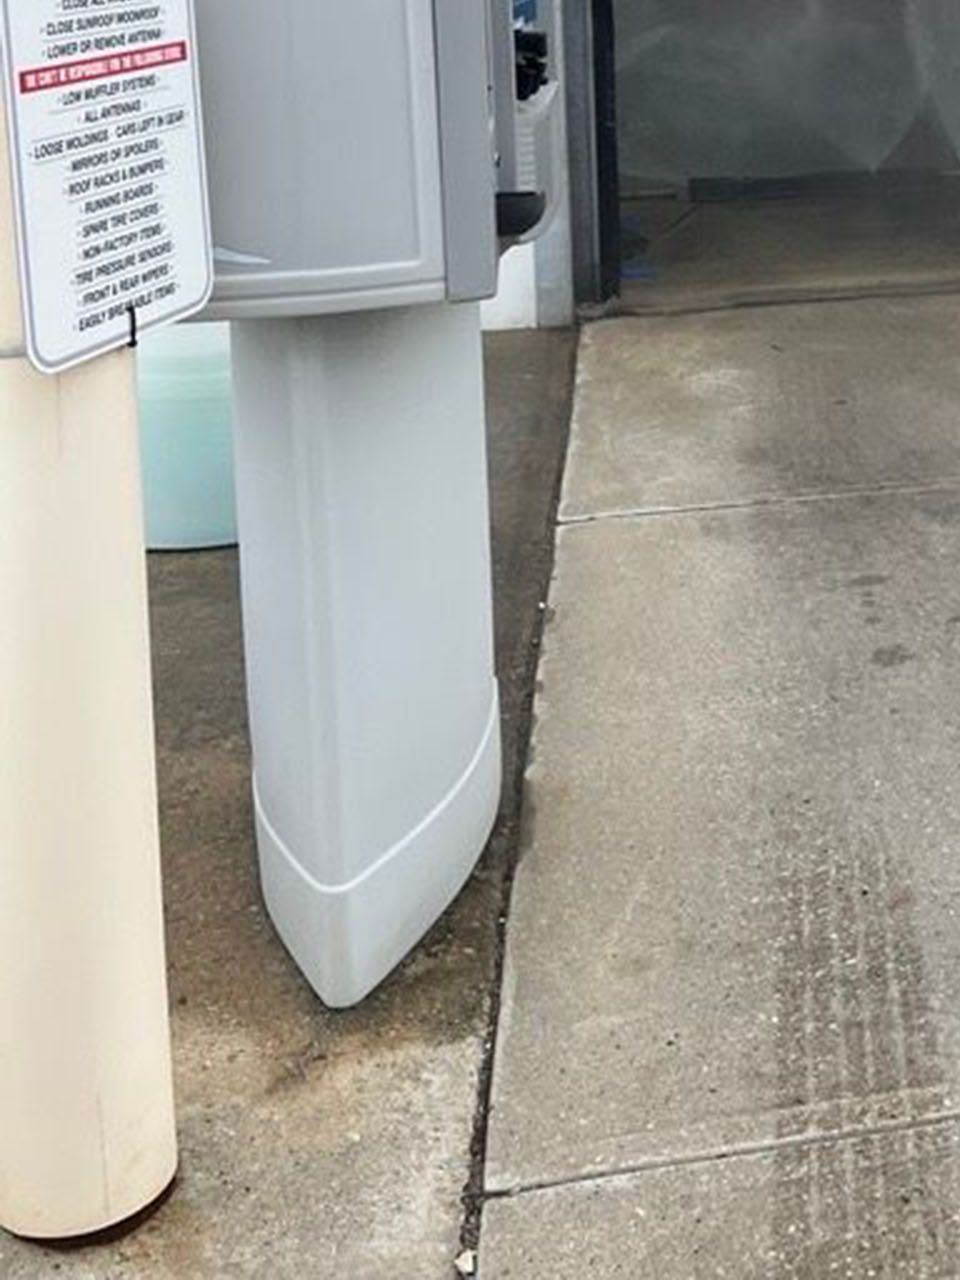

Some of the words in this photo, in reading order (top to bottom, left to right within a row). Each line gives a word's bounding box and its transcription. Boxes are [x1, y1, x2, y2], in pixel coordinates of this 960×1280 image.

[46, 20, 74, 36] CLOSE
[48, 43, 78, 59] LOWER
[80, 40, 92, 53] OR
[94, 32, 126, 50] REMOVE
[62, 90, 82, 106] LOW
[84, 82, 120, 100] MUFFLER
[122, 74, 157, 92] SYSTEMS
[84, 110, 98, 122] ALL
[100, 98, 141, 119] ANTENNAS
[34, 138, 64, 160] LOOSE
[66, 128, 108, 151] MOLDINGS
[72, 152, 108, 172] MIRRORS
[110, 148, 122, 160] OR
[123, 137, 159, 157] SPOILERS
[68, 178, 90, 195] ROOF
[93, 170, 120, 188] RACKS
[128, 157, 164, 176] BUMPERS
[84, 192, 121, 214] RUNNING
[122, 182, 154, 202] BOARDS
[82, 218, 108, 238] SPARE
[110, 212, 128, 228] TIRE
[129, 202, 158, 222] COVERS
[83, 232, 138, 259] NON-FACTORY
[140, 222, 162, 241] ITEMS
[76, 270, 93, 285] TIRE
[95, 253, 136, 278] PRESSURE
[138, 240, 172, 262] SENSORS
[82, 284, 110, 304] FRONT
[120, 274, 140, 292] REAR
[142, 263, 169, 283] WIPERS
